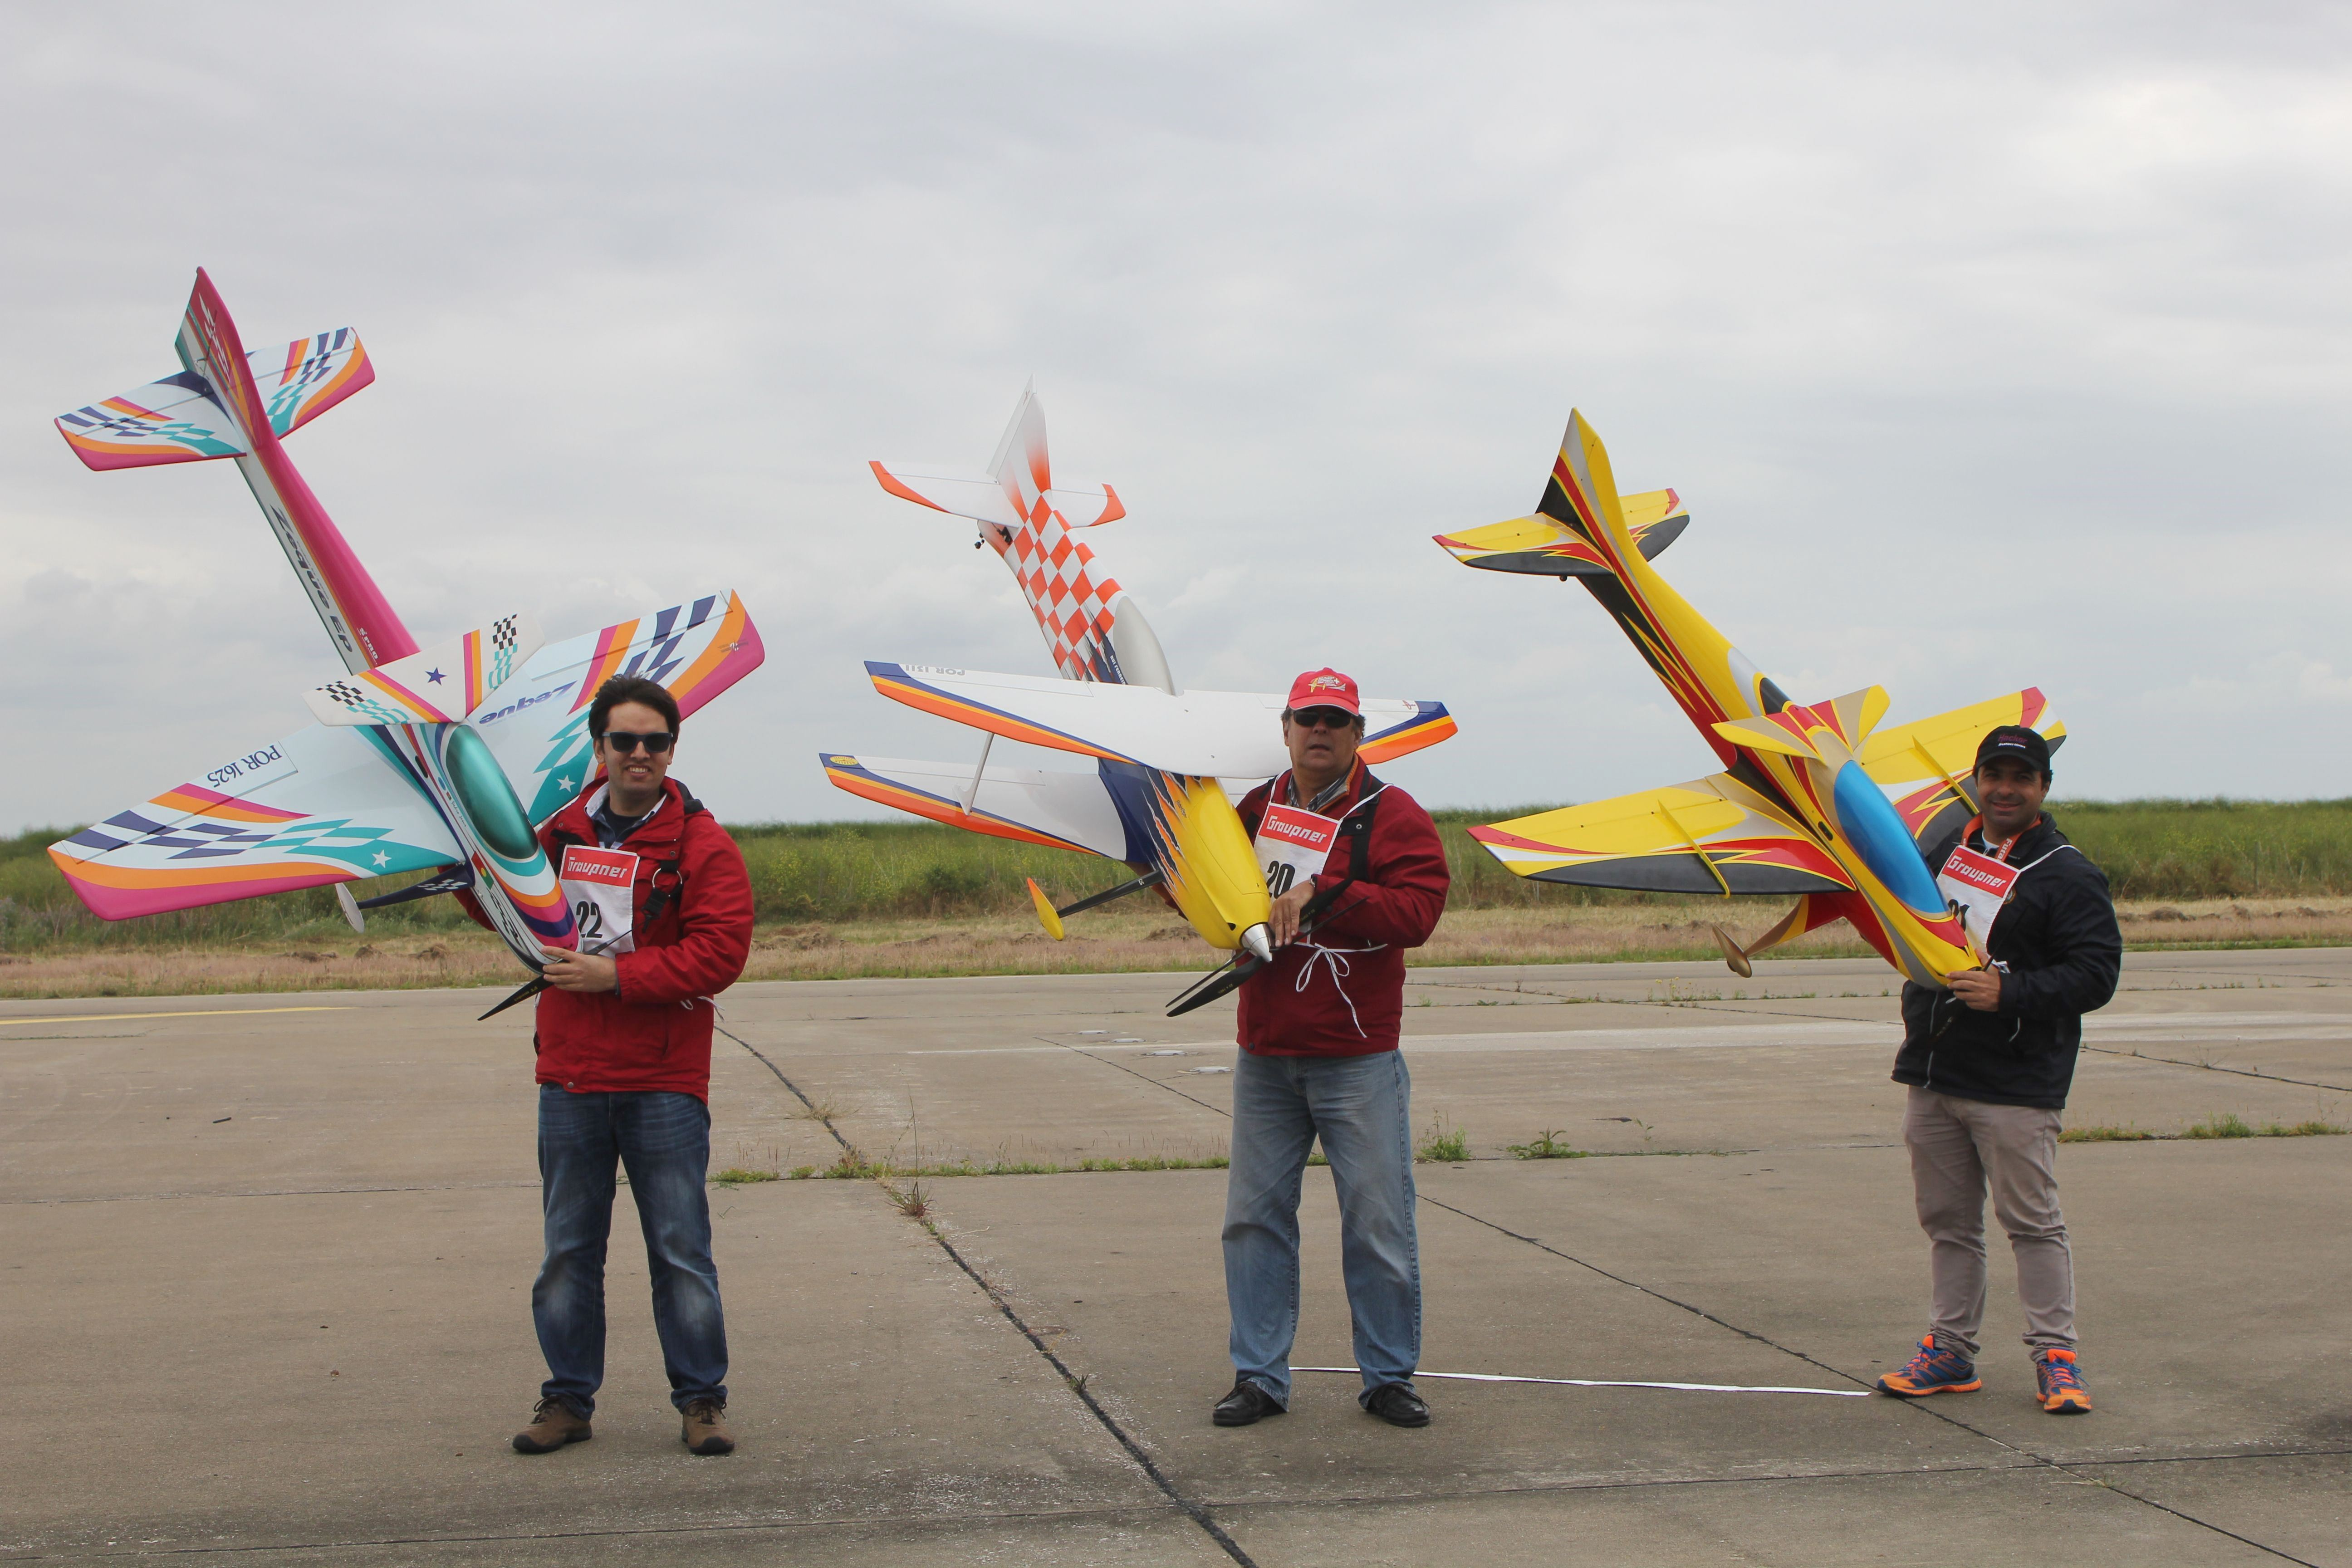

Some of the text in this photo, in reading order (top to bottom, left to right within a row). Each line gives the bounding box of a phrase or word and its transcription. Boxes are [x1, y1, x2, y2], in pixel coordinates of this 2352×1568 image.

[270, 504, 330, 609] Zeque
[936, 667, 965, 676] POR
[479, 680, 578, 725] Zeque
[1998, 733, 2028, 743] Hacker
[207, 745, 283, 788] POR 1625
[1266, 815, 1328, 843] Graupner
[1997, 838, 2013, 860] Futa
[567, 857, 627, 878] Graupner
[1266, 860, 1295, 899] 20
[1947, 855, 2007, 888] Graupner
[576, 901, 603, 938] 22
